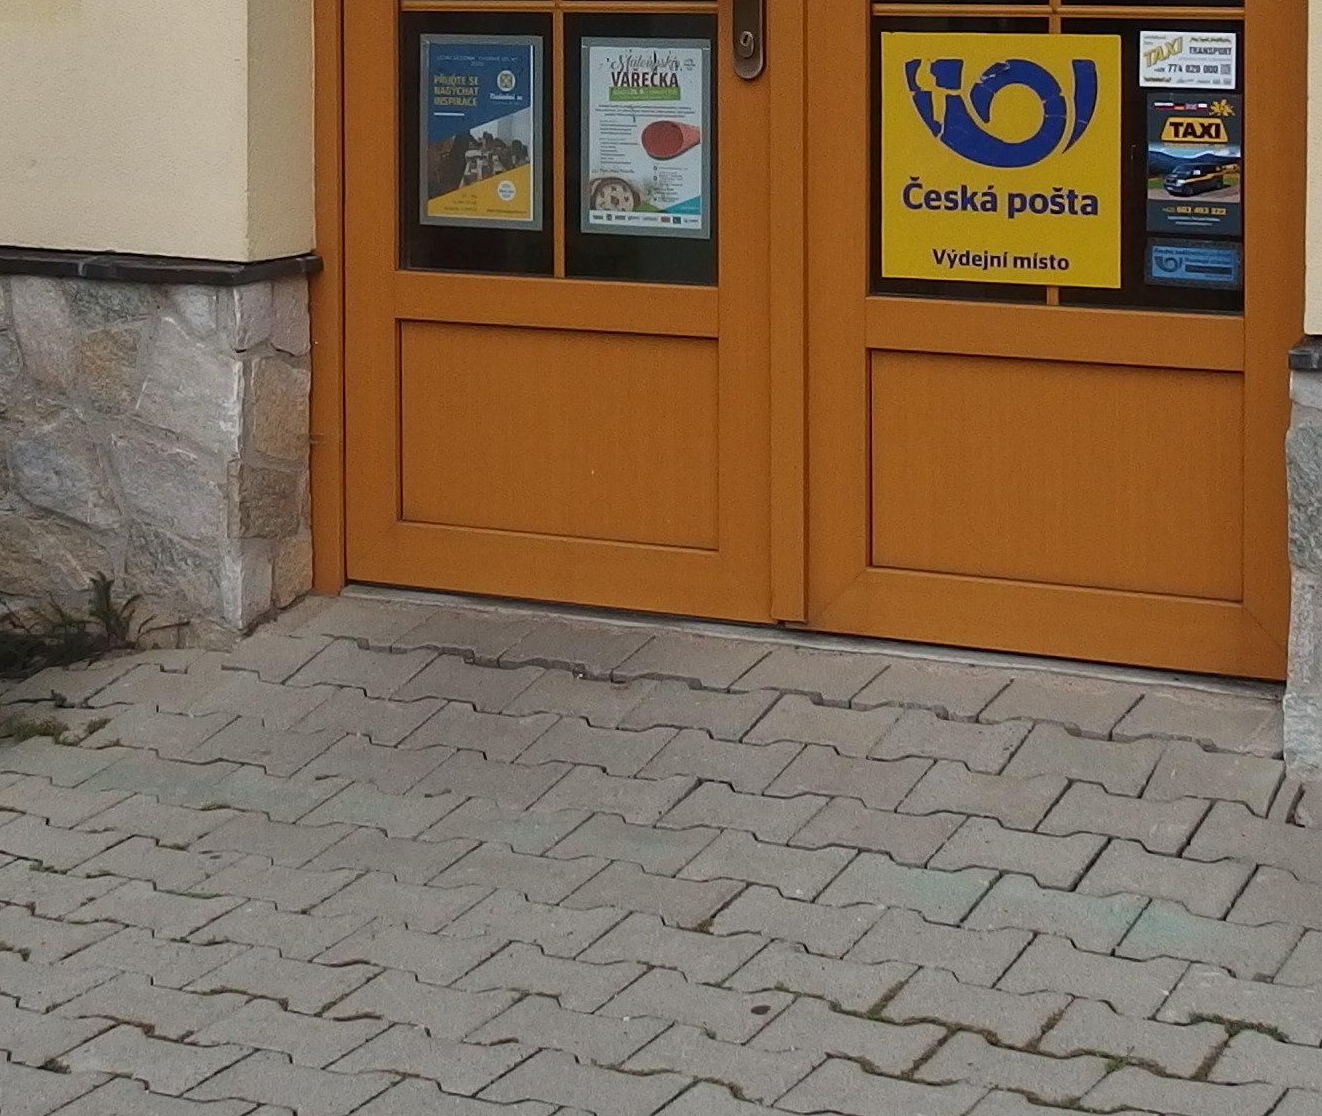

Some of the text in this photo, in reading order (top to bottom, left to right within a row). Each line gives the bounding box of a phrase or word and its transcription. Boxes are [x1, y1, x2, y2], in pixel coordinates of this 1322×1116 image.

[1144, 36, 1183, 68] TAXI
[1189, 47, 1231, 55] TRANSPORT
[611, 68, 678, 87] VAŘEČKA
[1169, 122, 1220, 138] TAXI
[902, 176, 1099, 219] Česká pošta
[933, 248, 1070, 271] Výdejní místo
